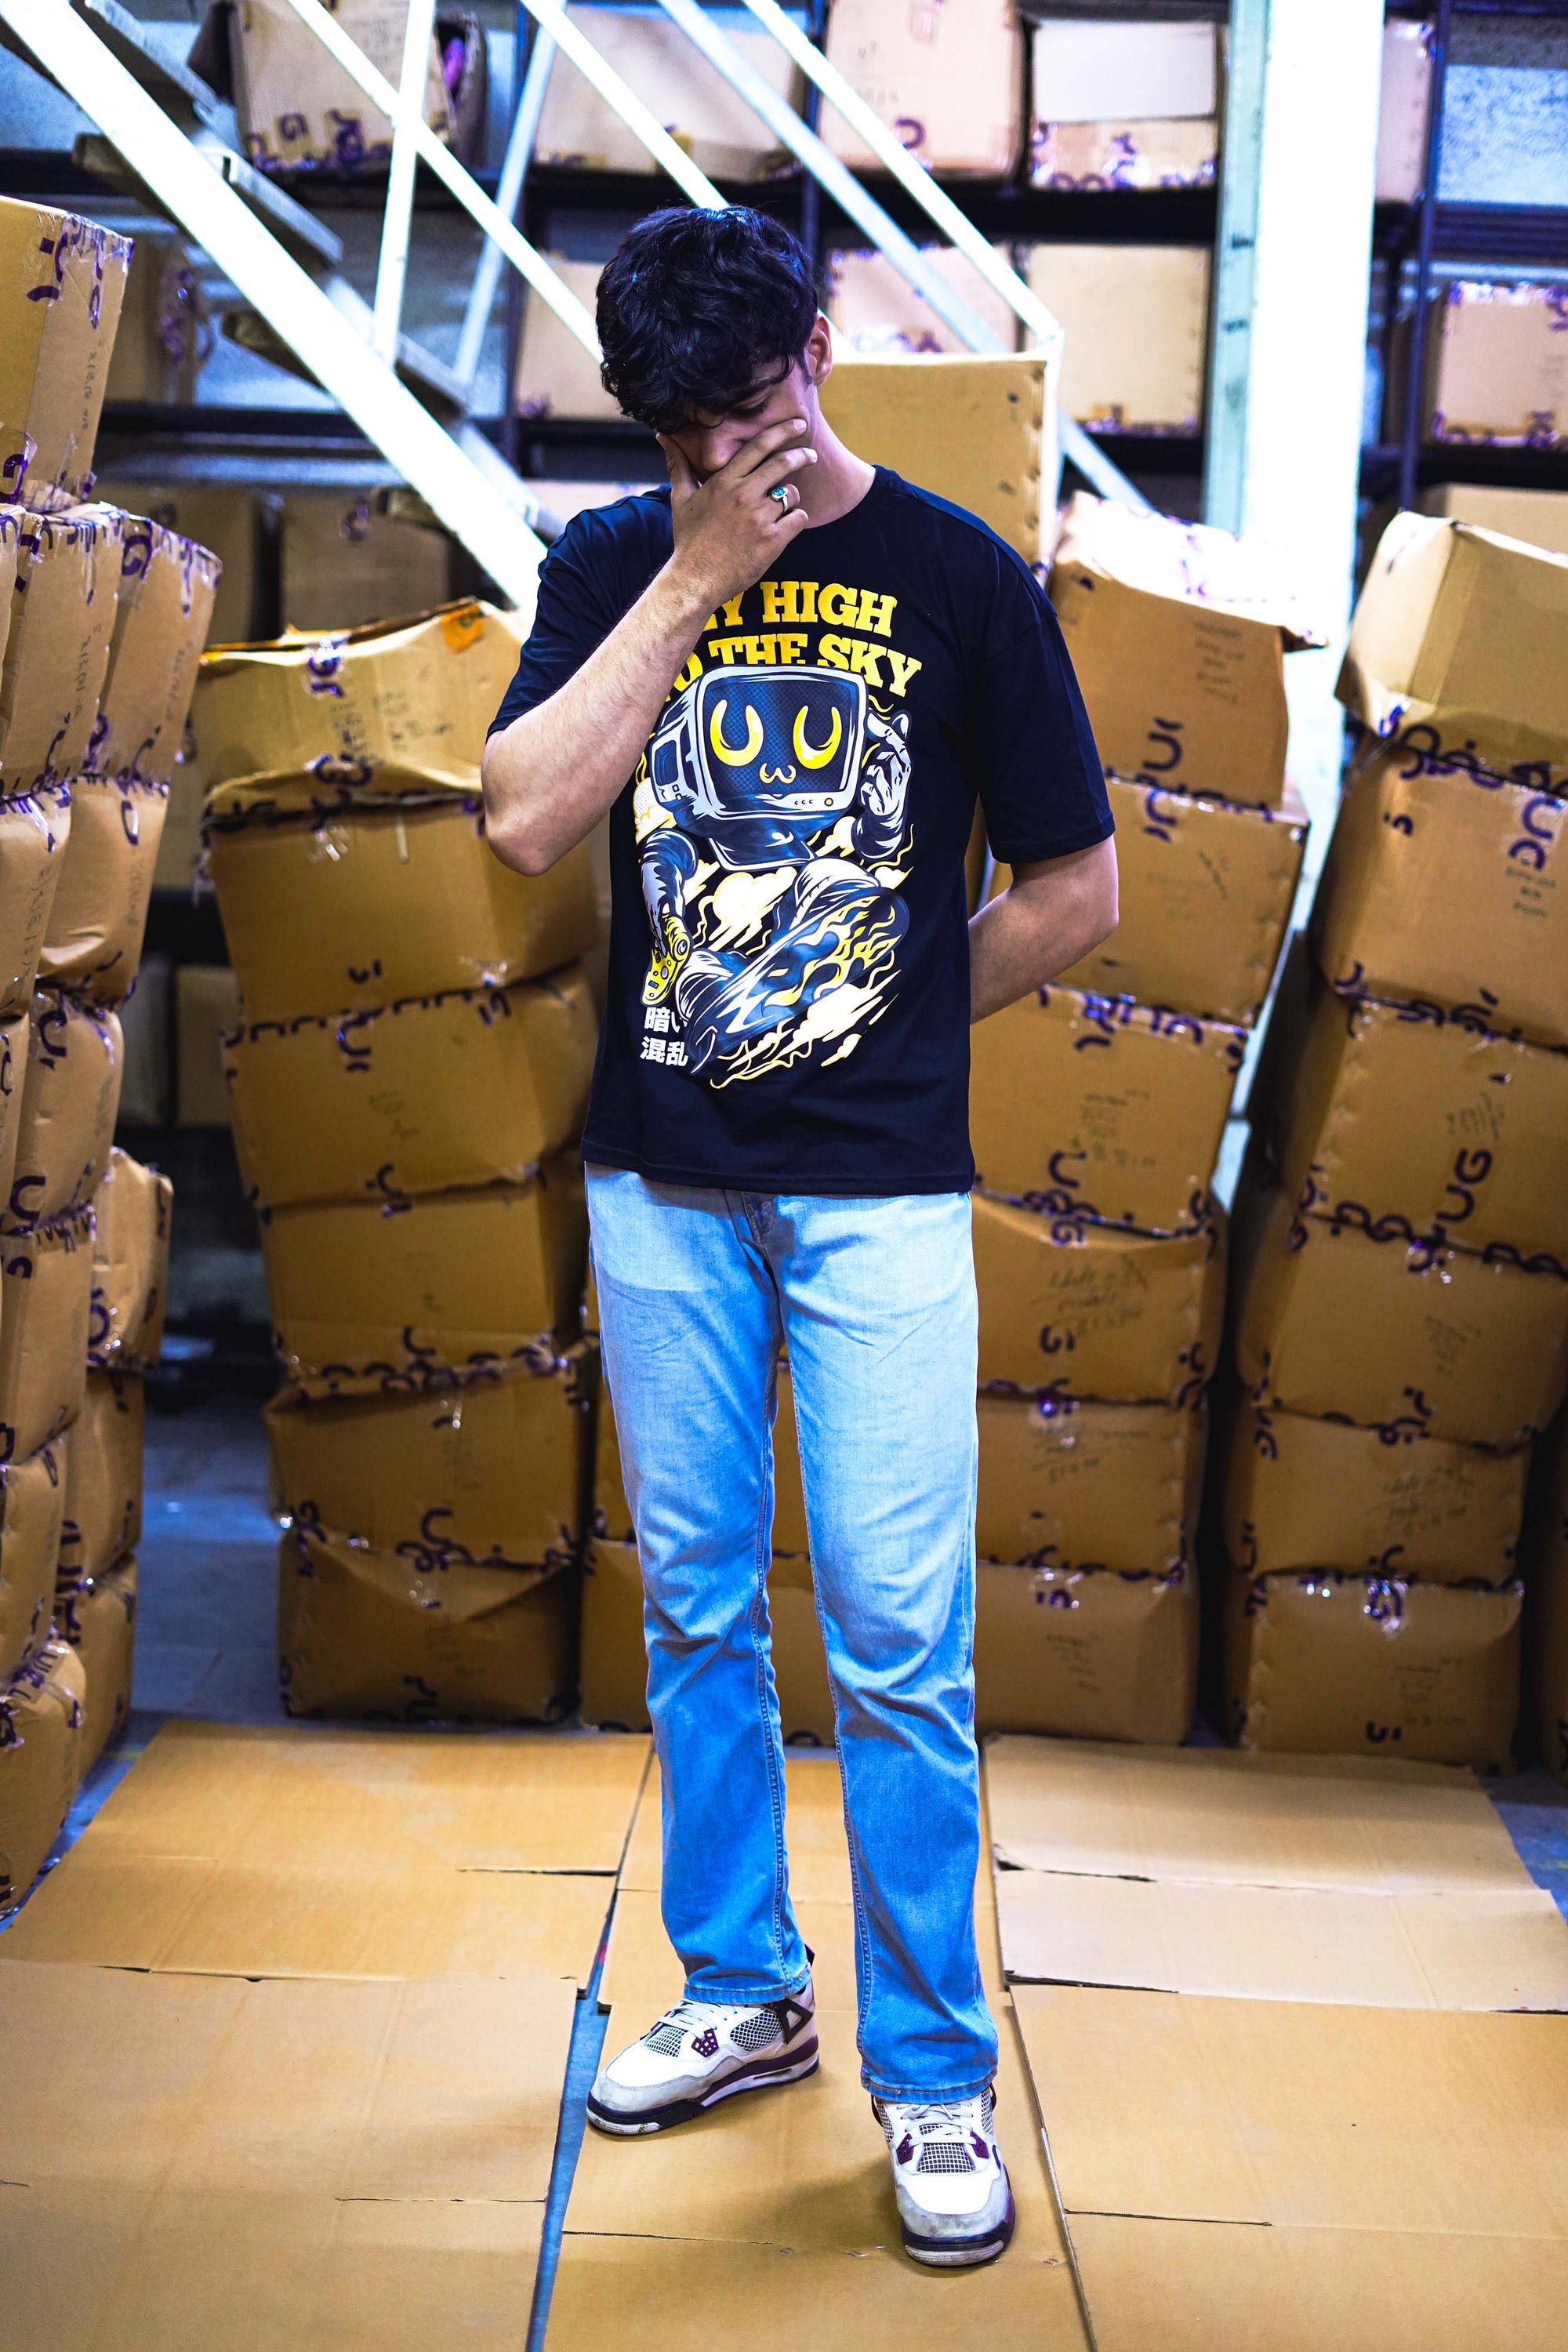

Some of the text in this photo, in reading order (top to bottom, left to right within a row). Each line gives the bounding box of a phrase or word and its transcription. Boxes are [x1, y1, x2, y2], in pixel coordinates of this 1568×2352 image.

[760, 581, 898, 637] HIGH
[707, 633, 808, 665] THE
[817, 633, 922, 698] SKY
[639, 1035, 689, 1066] 混乱
